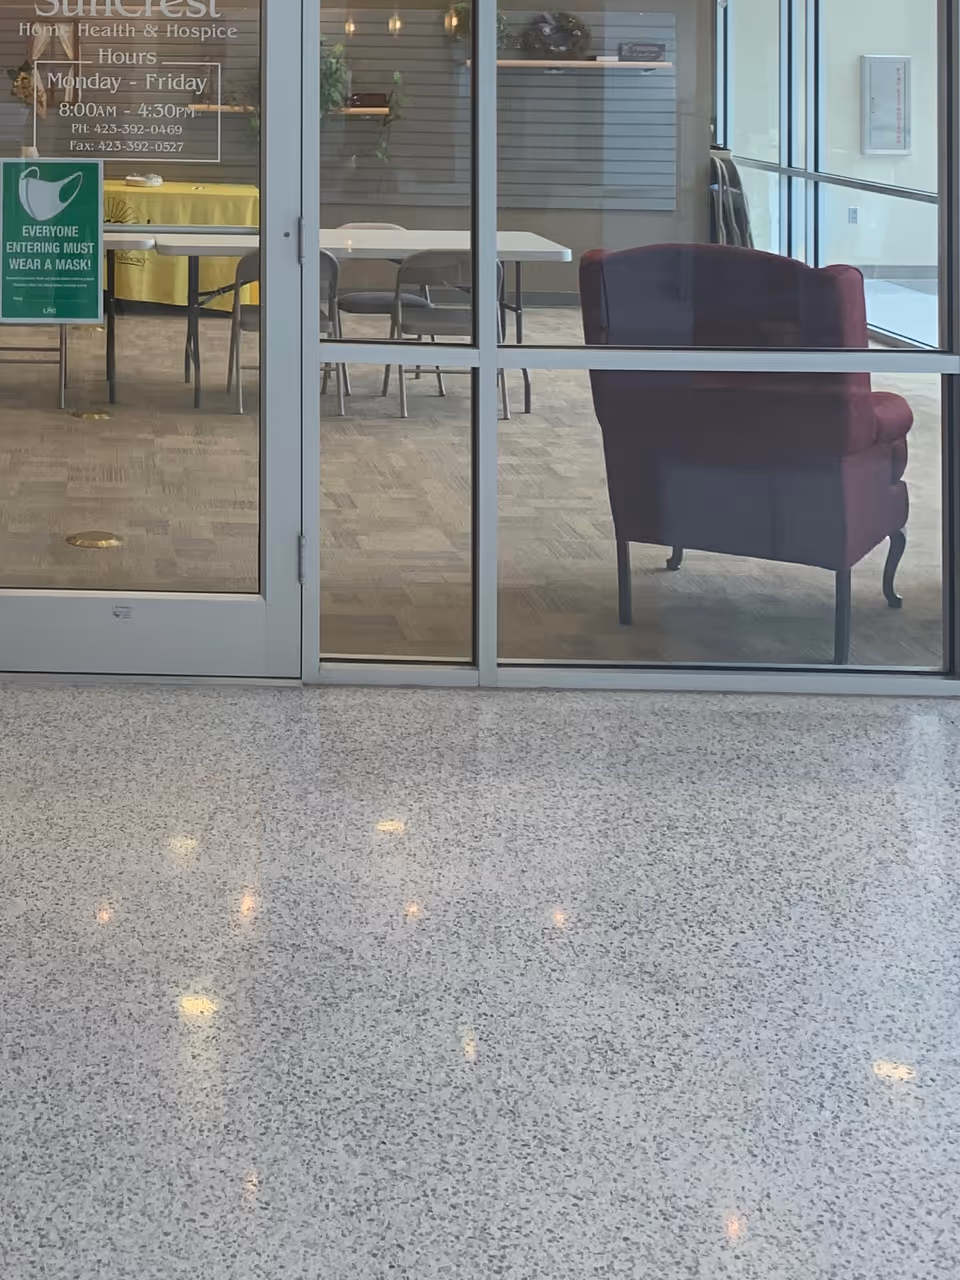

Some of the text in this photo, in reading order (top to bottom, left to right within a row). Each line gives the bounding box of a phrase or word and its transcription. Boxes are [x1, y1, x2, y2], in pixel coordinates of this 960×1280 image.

[19, 22, 238, 41] Home Health & Hospice
[98, 48, 157, 65] Hours
[47, 73, 122, 93] Monday
[145, 73, 208, 94] Friday
[59, 102, 117, 117] 8:00AM
[137, 103, 195, 118] 4:30PM
[94, 124, 183, 135] 423-392-0469
[70, 141, 184, 152] Fax: 423-392-0527
[22, 225, 79, 237] EVERYONE
[6, 241, 95, 254] ENTERING MUST
[9, 258, 91, 270] WEAR A MASK!
